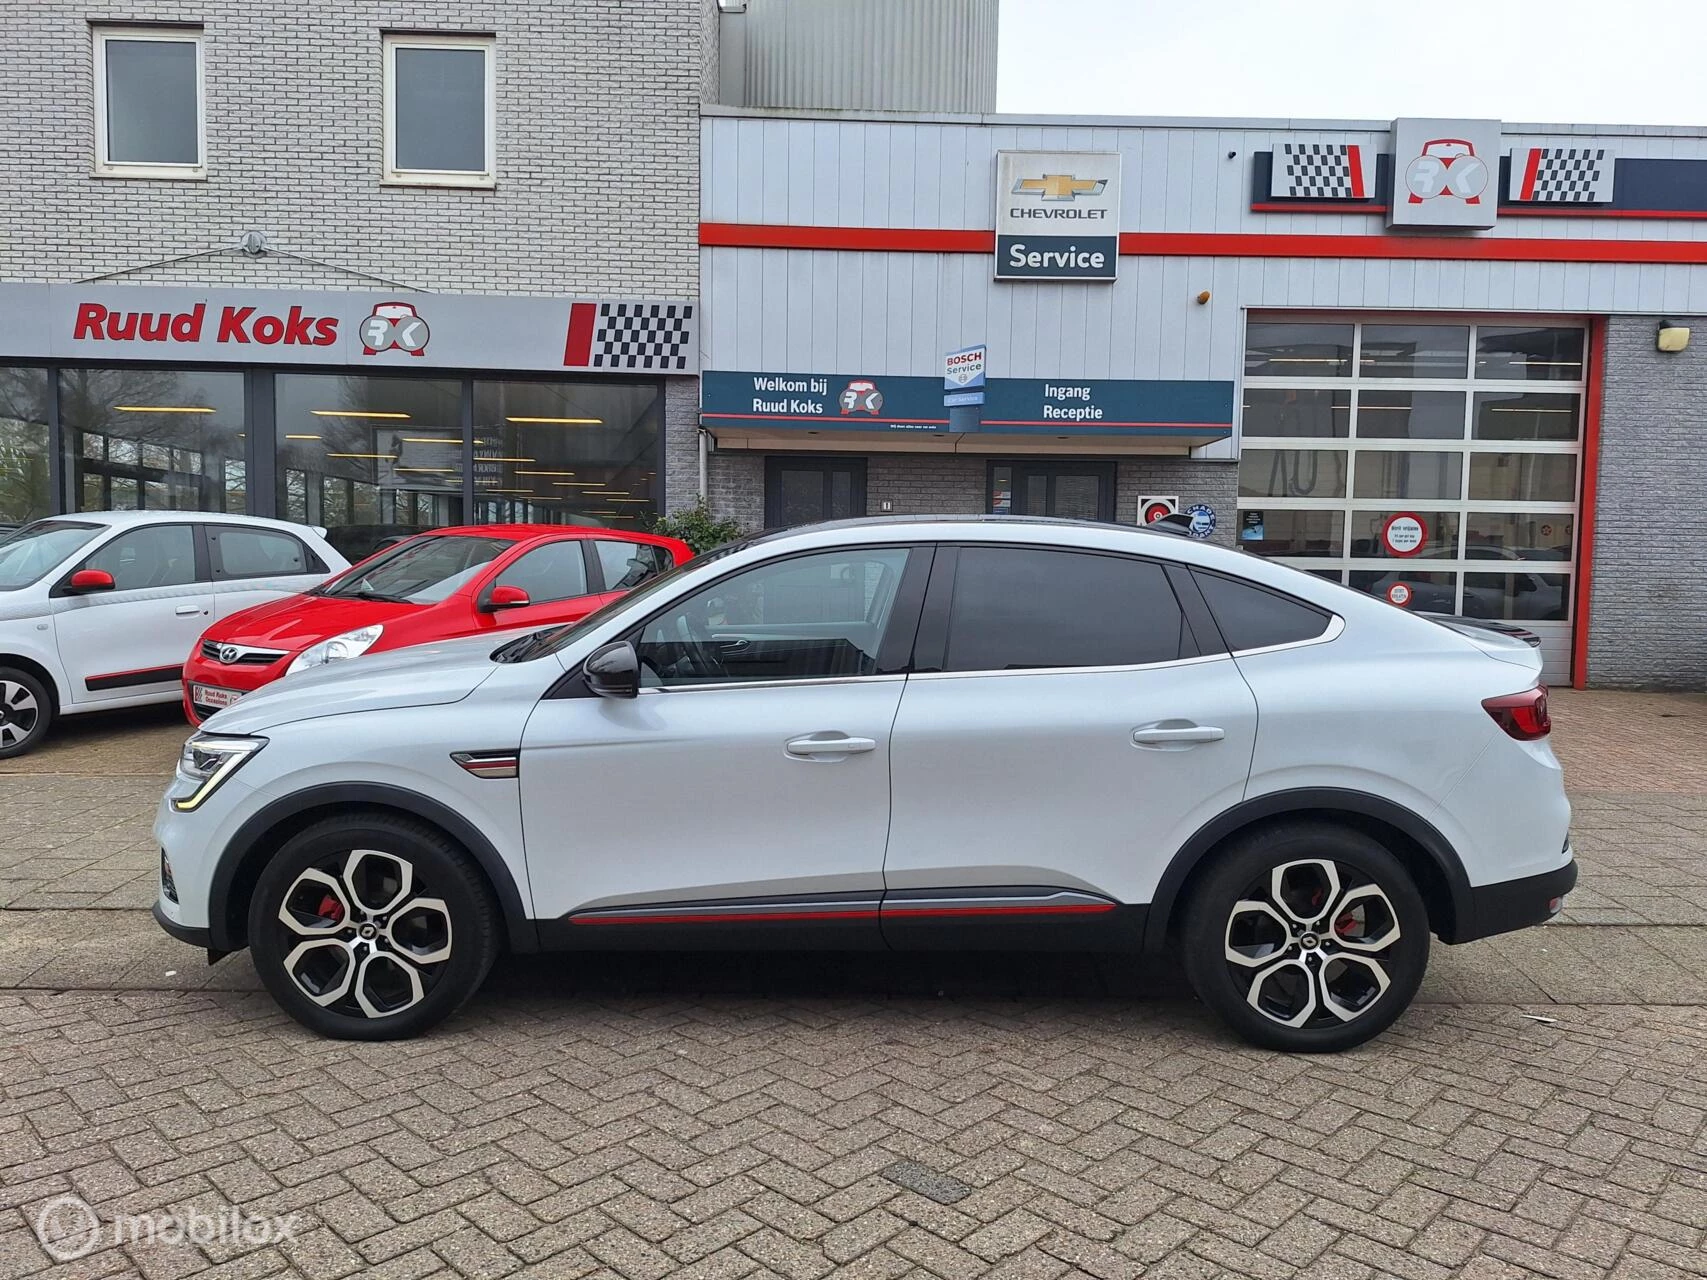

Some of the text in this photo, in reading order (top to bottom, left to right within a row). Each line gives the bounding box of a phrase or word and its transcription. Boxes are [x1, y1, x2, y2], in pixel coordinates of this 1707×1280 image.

[1009, 207, 1108, 220] CHEVROLET
[1009, 243, 1105, 268] Service
[73, 302, 340, 347] Ruud Koks
[946, 351, 982, 366] BOSCH
[946, 363, 982, 375] Service
[753, 377, 827, 395] Welkom bij
[1044, 383, 1091, 401] Ingang
[752, 398, 823, 414] Ruud Koks
[1043, 404, 1103, 422] Receptie
